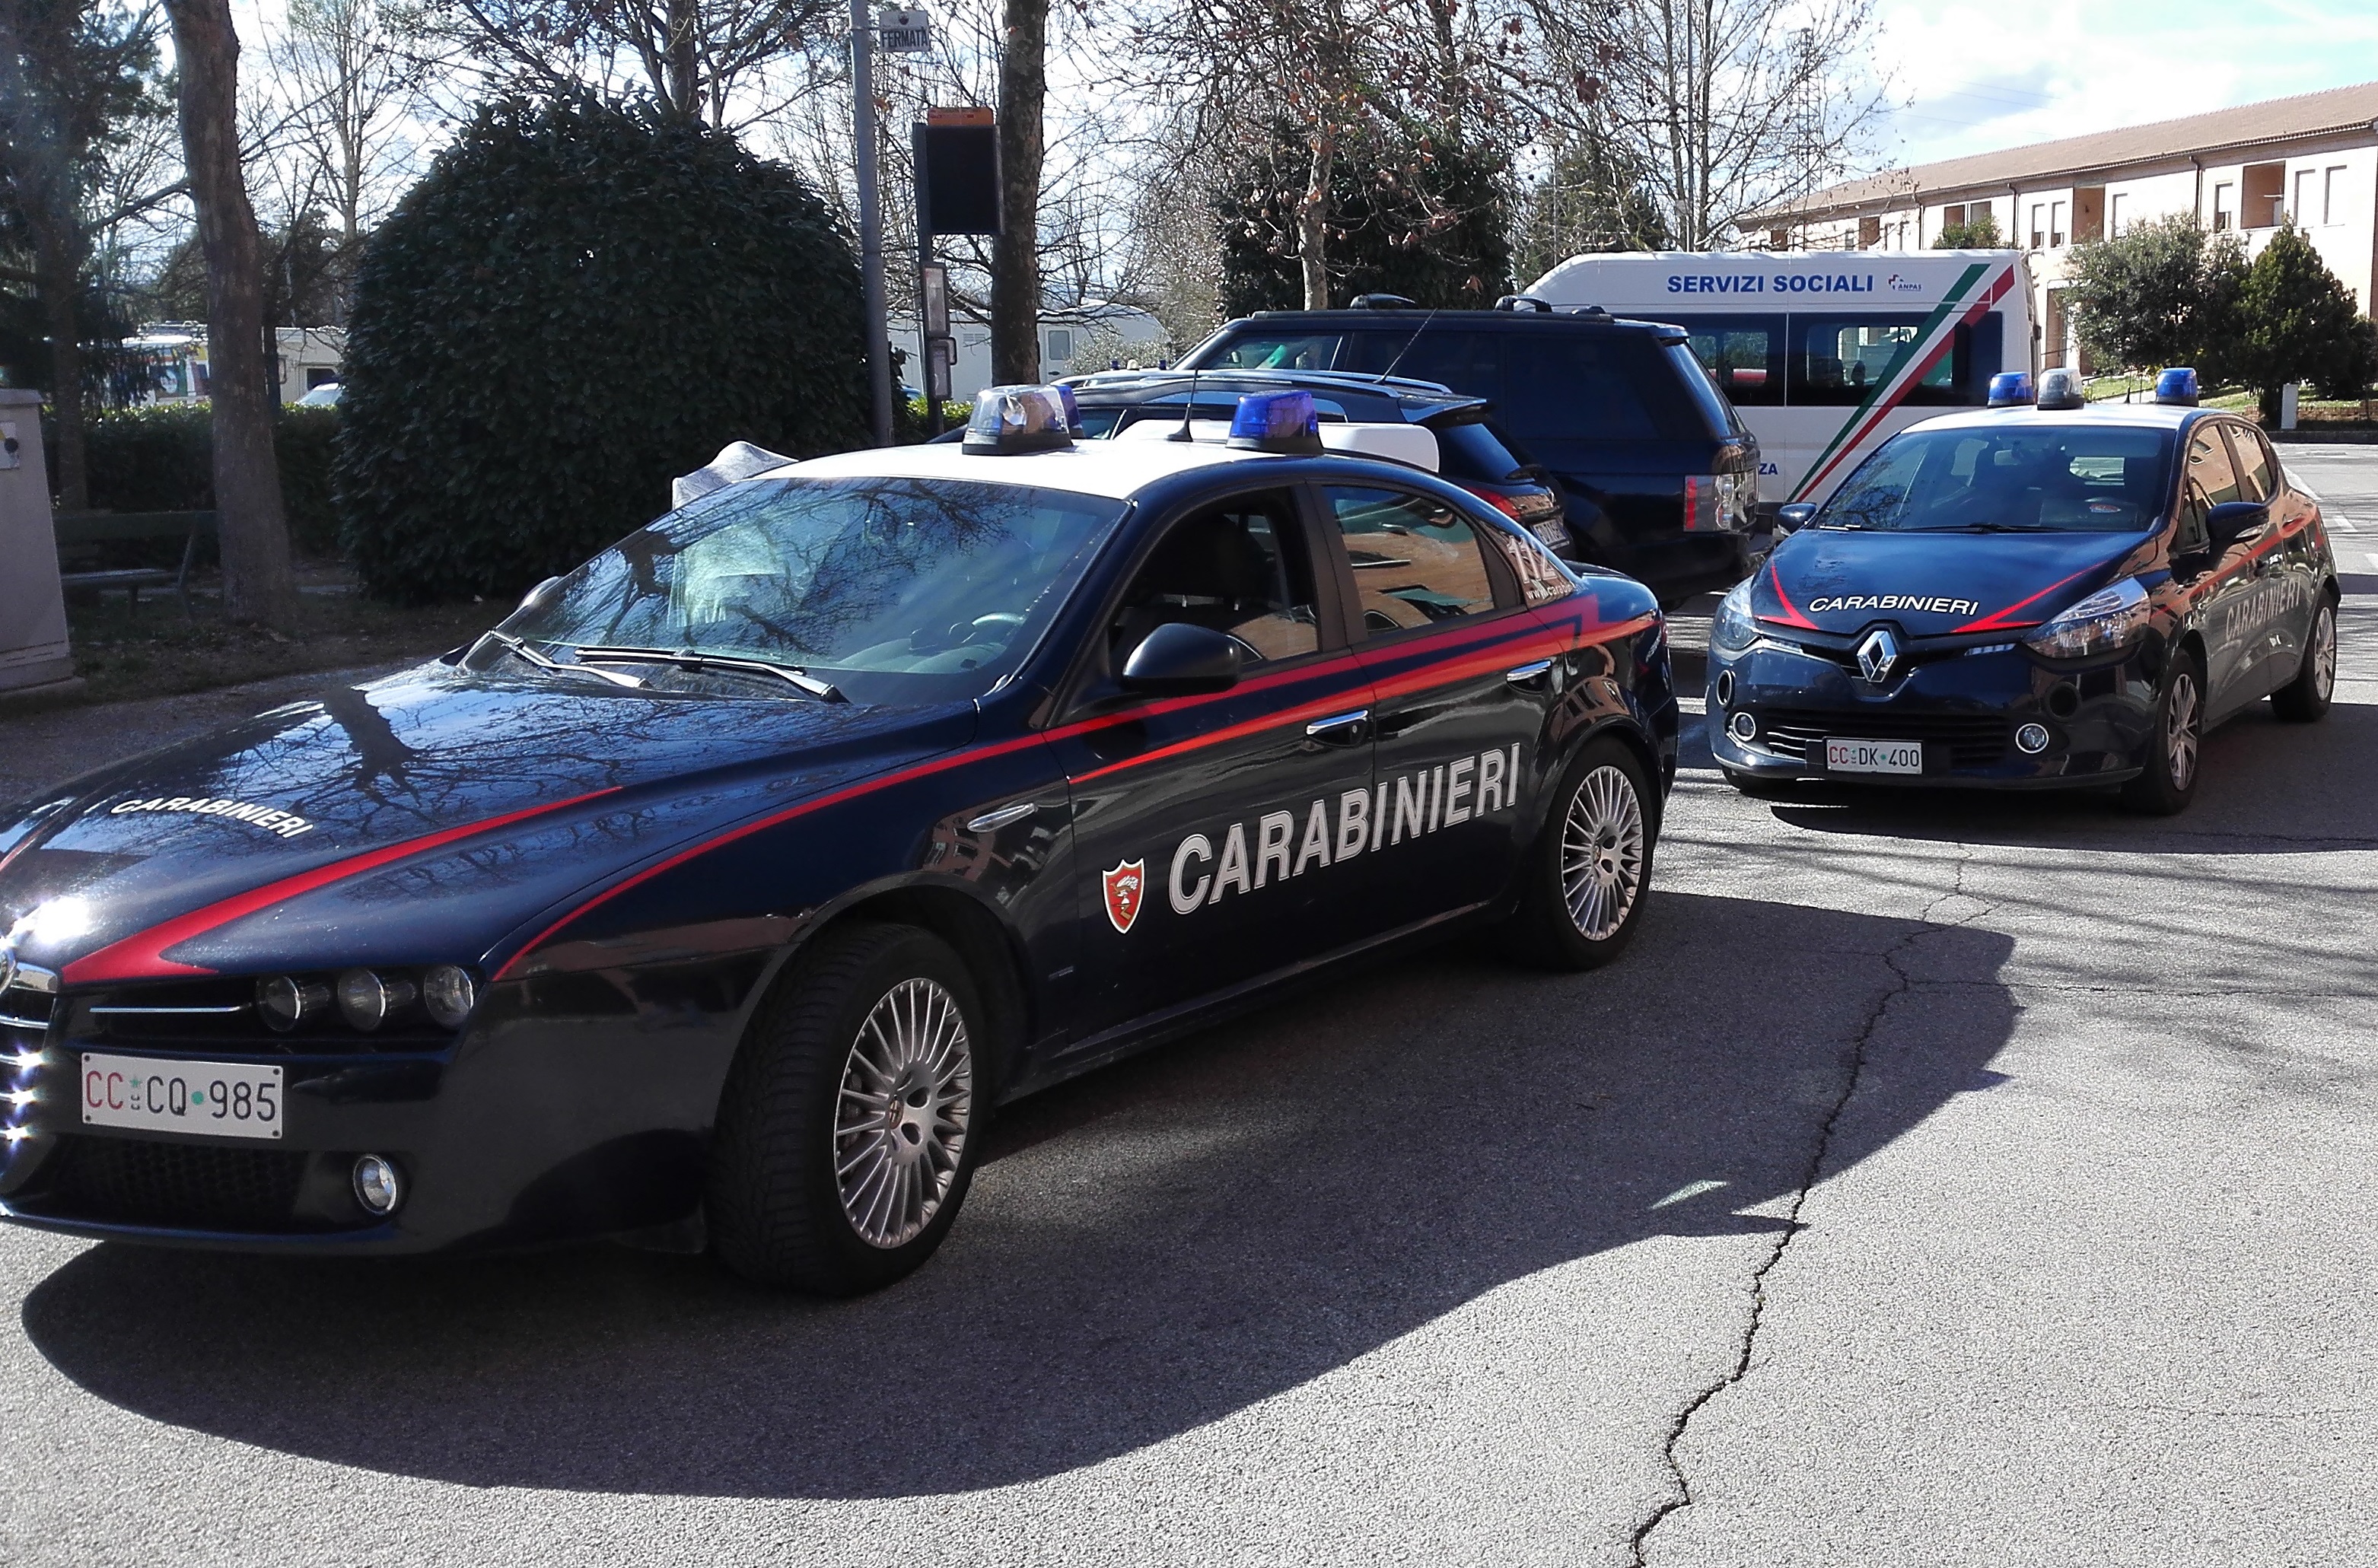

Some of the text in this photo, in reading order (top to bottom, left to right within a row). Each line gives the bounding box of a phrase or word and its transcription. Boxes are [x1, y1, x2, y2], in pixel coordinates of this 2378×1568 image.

[881, 30, 928, 47] FERMATA
[1667, 275, 1873, 293] SERVIZI SOCIALI
[1507, 535, 1558, 584] 112
[1809, 595, 1978, 615] CARABINIERI
[2226, 576, 2300, 641] CARABINIERI
[1829, 746, 1848, 764] CC
[1859, 748, 1878, 765] DK
[1889, 749, 1919, 767] 400
[110, 797, 313, 838] CARABINIERI
[1169, 743, 1520, 915] CARABINIERI
[86, 1070, 123, 1110] CC
[147, 1076, 186, 1116] CQ
[209, 1080, 275, 1121] 985
